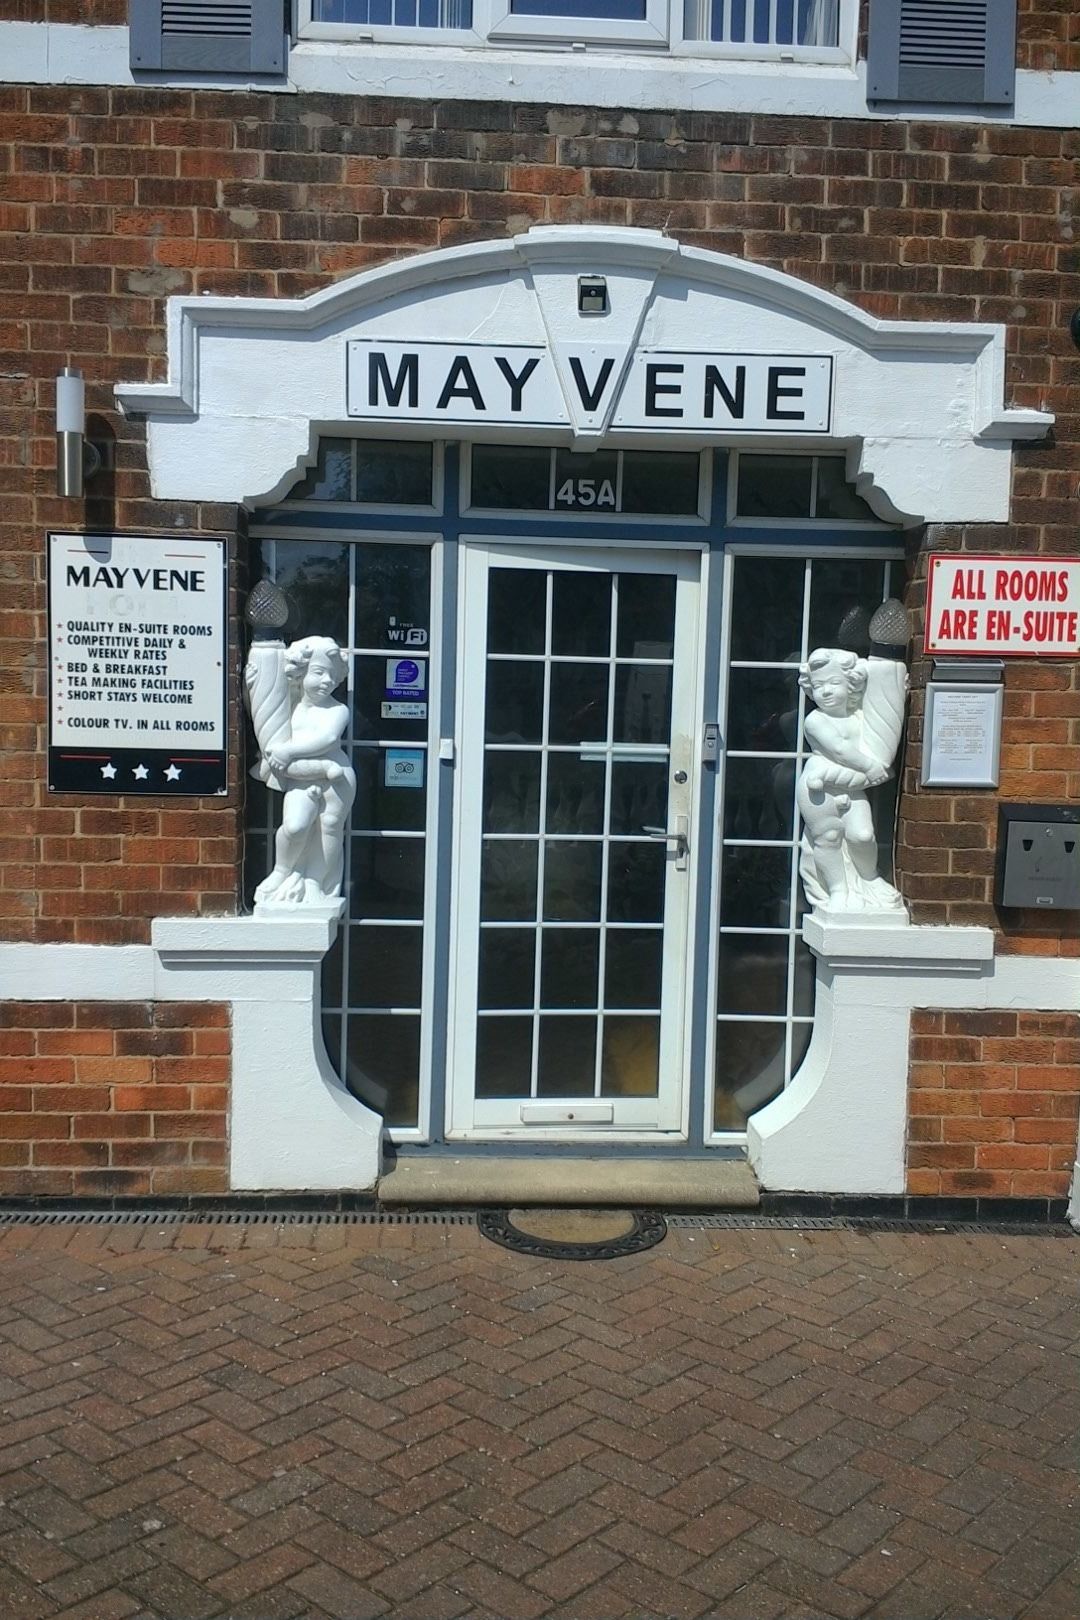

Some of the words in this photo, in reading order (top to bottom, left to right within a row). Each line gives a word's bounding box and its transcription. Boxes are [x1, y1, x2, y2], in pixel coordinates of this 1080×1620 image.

[368, 352, 806, 421] MAYVENE
[556, 478, 616, 506] 45A
[66, 565, 206, 592] MAYVENE
[951, 569, 986, 600] ALL
[994, 570, 1069, 602] ROOMS
[67, 620, 114, 633] QUALITY
[118, 622, 168, 635] EN-SUITE
[172, 624, 213, 636] ROOMS
[938, 609, 978, 640] ARE
[986, 610, 1078, 642] EN-SUITE
[67, 634, 140, 648] COMPETITIVE
[143, 637, 174, 649] DAILY
[178, 638, 186, 649] &
[87, 647, 130, 660] WEEKLY
[133, 649, 167, 661] RATES
[67, 662, 88, 673] BED
[92, 663, 101, 674] &
[104, 663, 168, 676] BREAKFAST
[67, 676, 88, 687] TEA
[91, 677, 137, 689] MAKING
[141, 678, 195, 691] FACILITIES
[67, 690, 103, 701] SHORT
[106, 691, 138, 703] STAYS
[141, 692, 193, 705] WELCOME
[67, 717, 110, 729] COLOUR
[113, 718, 133, 730] TV.
[136, 719, 149, 730] IN
[152, 719, 172, 731] ALL
[175, 720, 216, 732] ROOMS
